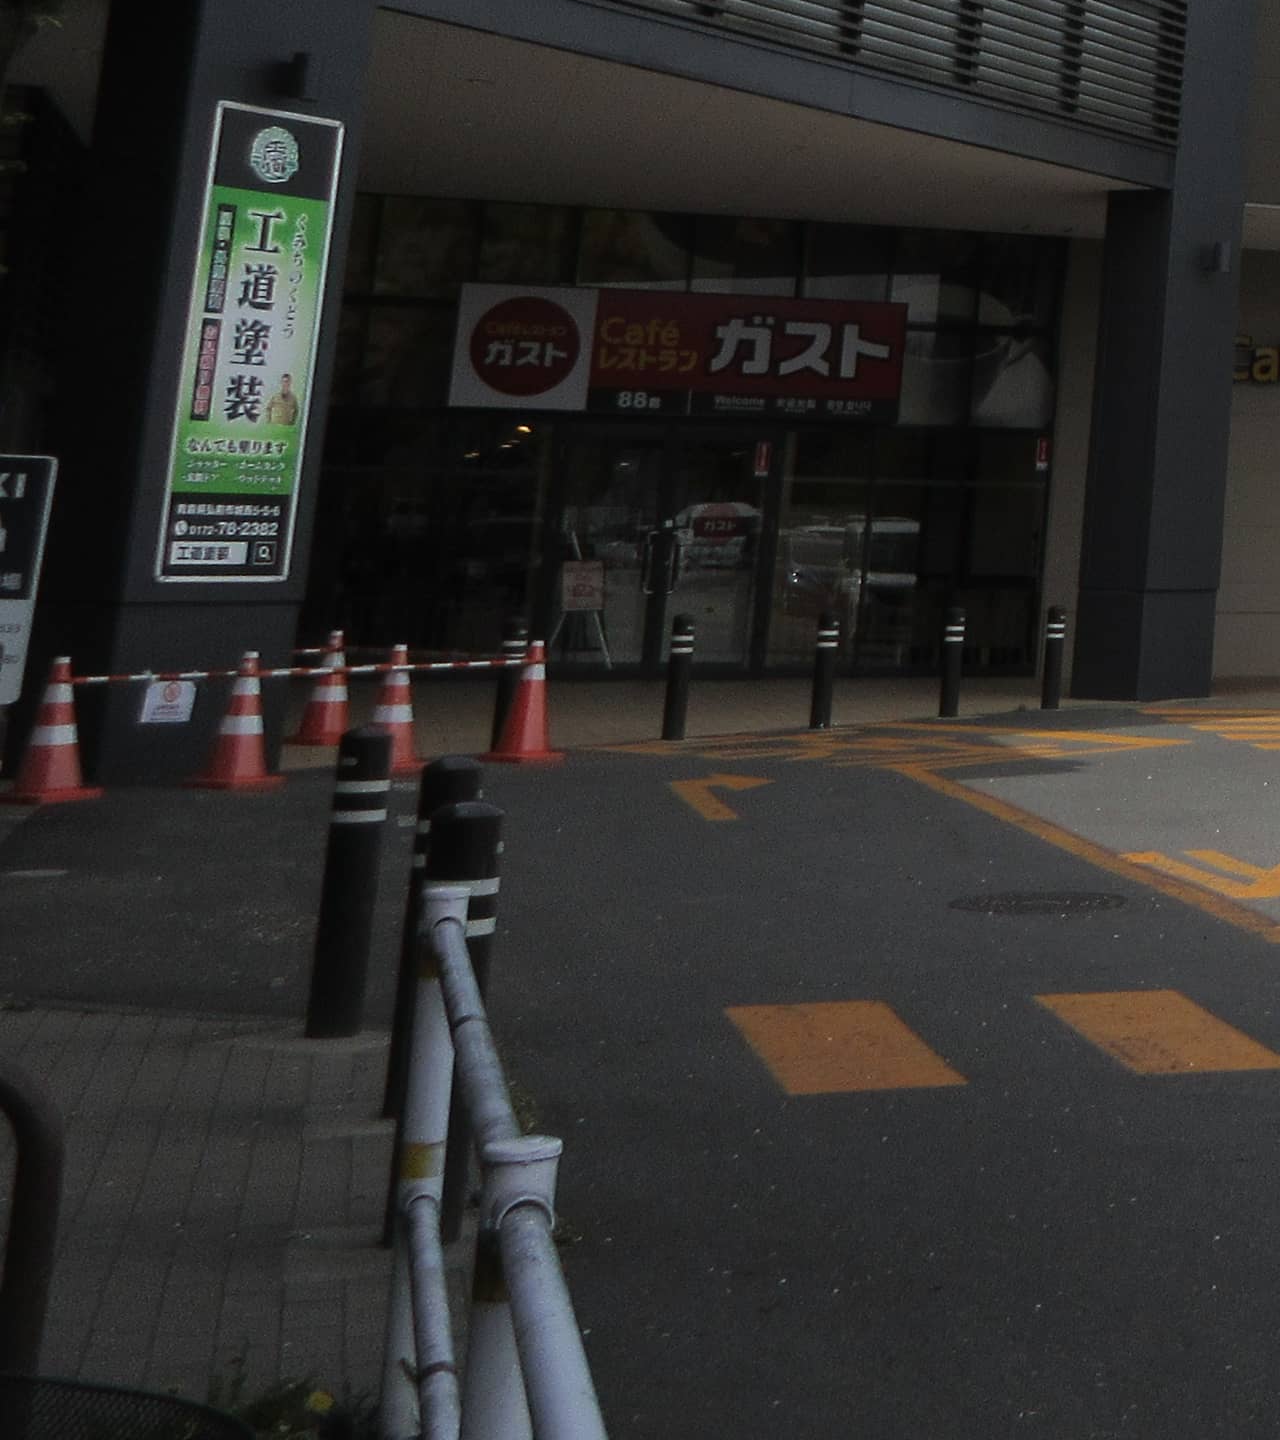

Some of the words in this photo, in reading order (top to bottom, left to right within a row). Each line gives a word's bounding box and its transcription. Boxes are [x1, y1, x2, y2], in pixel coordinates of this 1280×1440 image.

[223, 209, 287, 424] 工道塗装
[600, 316, 680, 347] Café
[484, 340, 568, 368] ガスト
[599, 348, 698, 373] レストラン
[710, 316, 890, 379] ガスト
